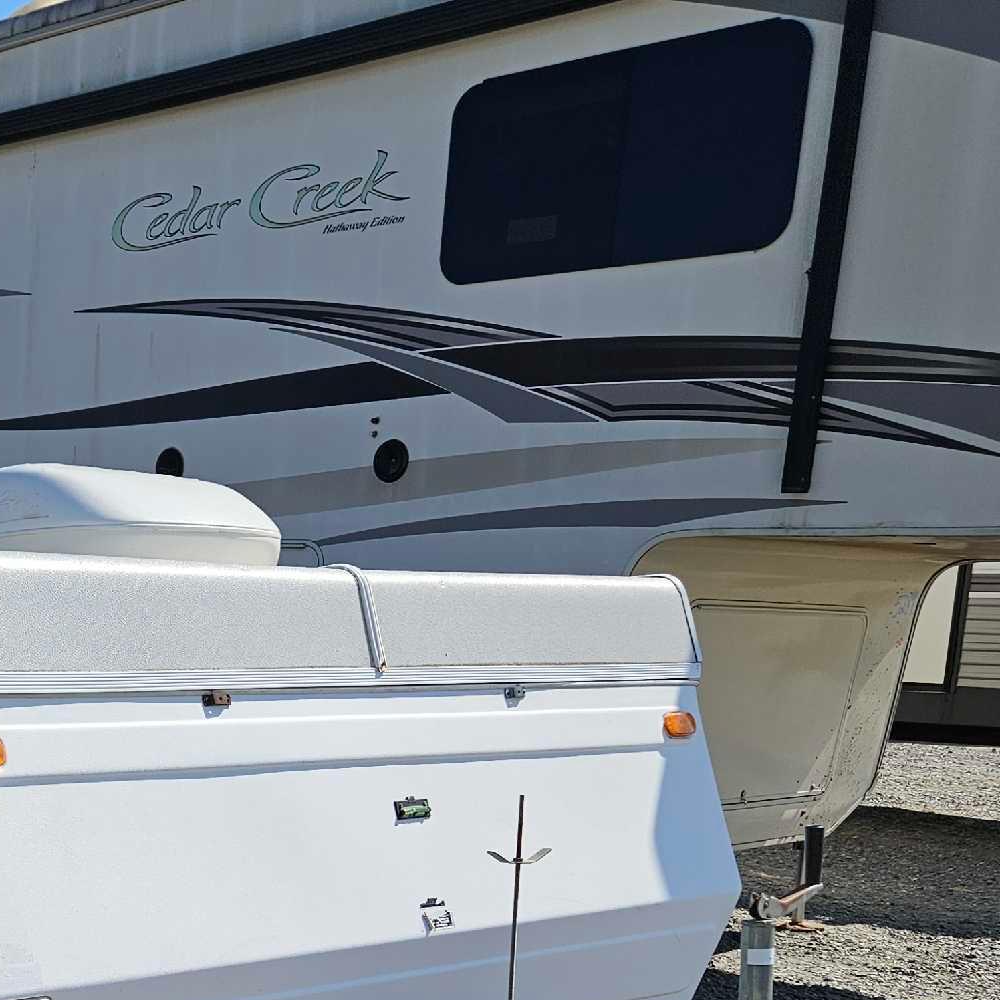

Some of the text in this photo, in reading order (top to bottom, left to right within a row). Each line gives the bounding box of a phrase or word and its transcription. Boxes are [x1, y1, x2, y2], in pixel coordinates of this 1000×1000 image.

[111, 149, 411, 252] Cedar Creek
[322, 215, 406, 235] Hathaway Edition
